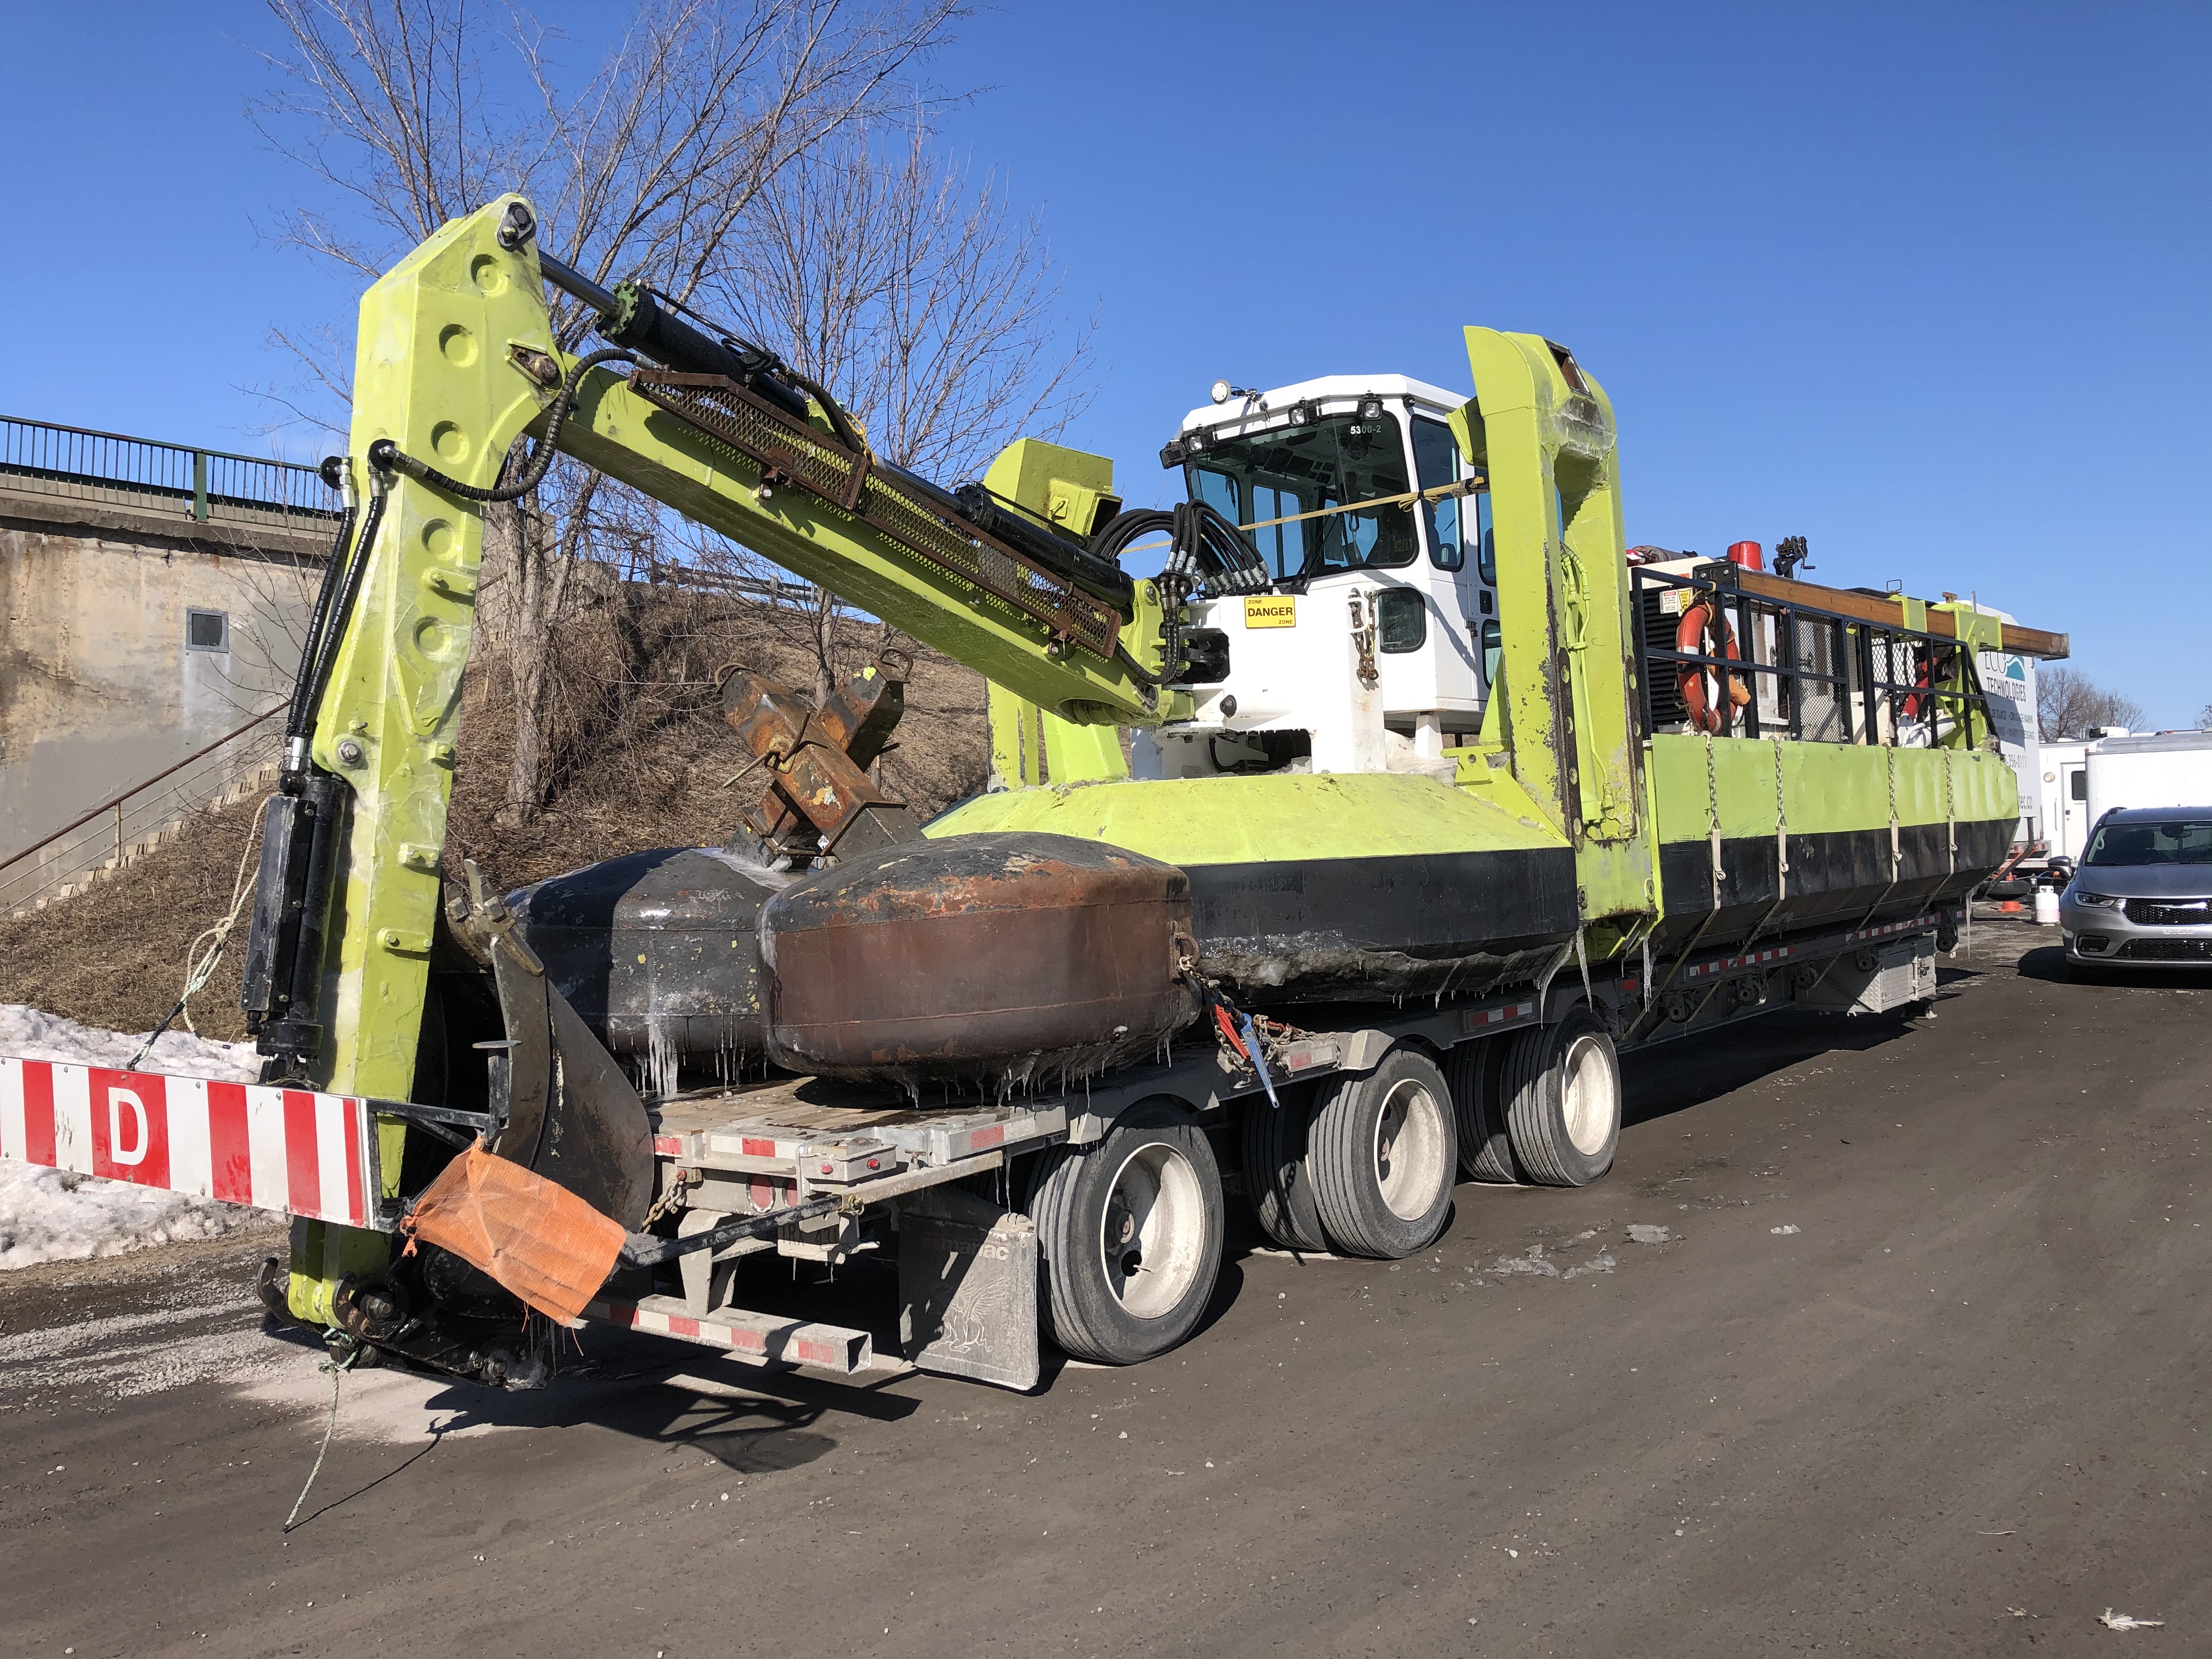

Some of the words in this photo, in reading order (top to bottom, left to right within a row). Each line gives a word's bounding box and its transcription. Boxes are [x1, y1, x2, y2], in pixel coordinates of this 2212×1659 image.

[1350, 425, 1381, 435] 5300-2
[1248, 607, 1293, 617] DANGER
[1986, 676, 2027, 702] TECHNOLOGIES
[108, 1087, 149, 1166] D
[941, 1238, 1009, 1261] manac
